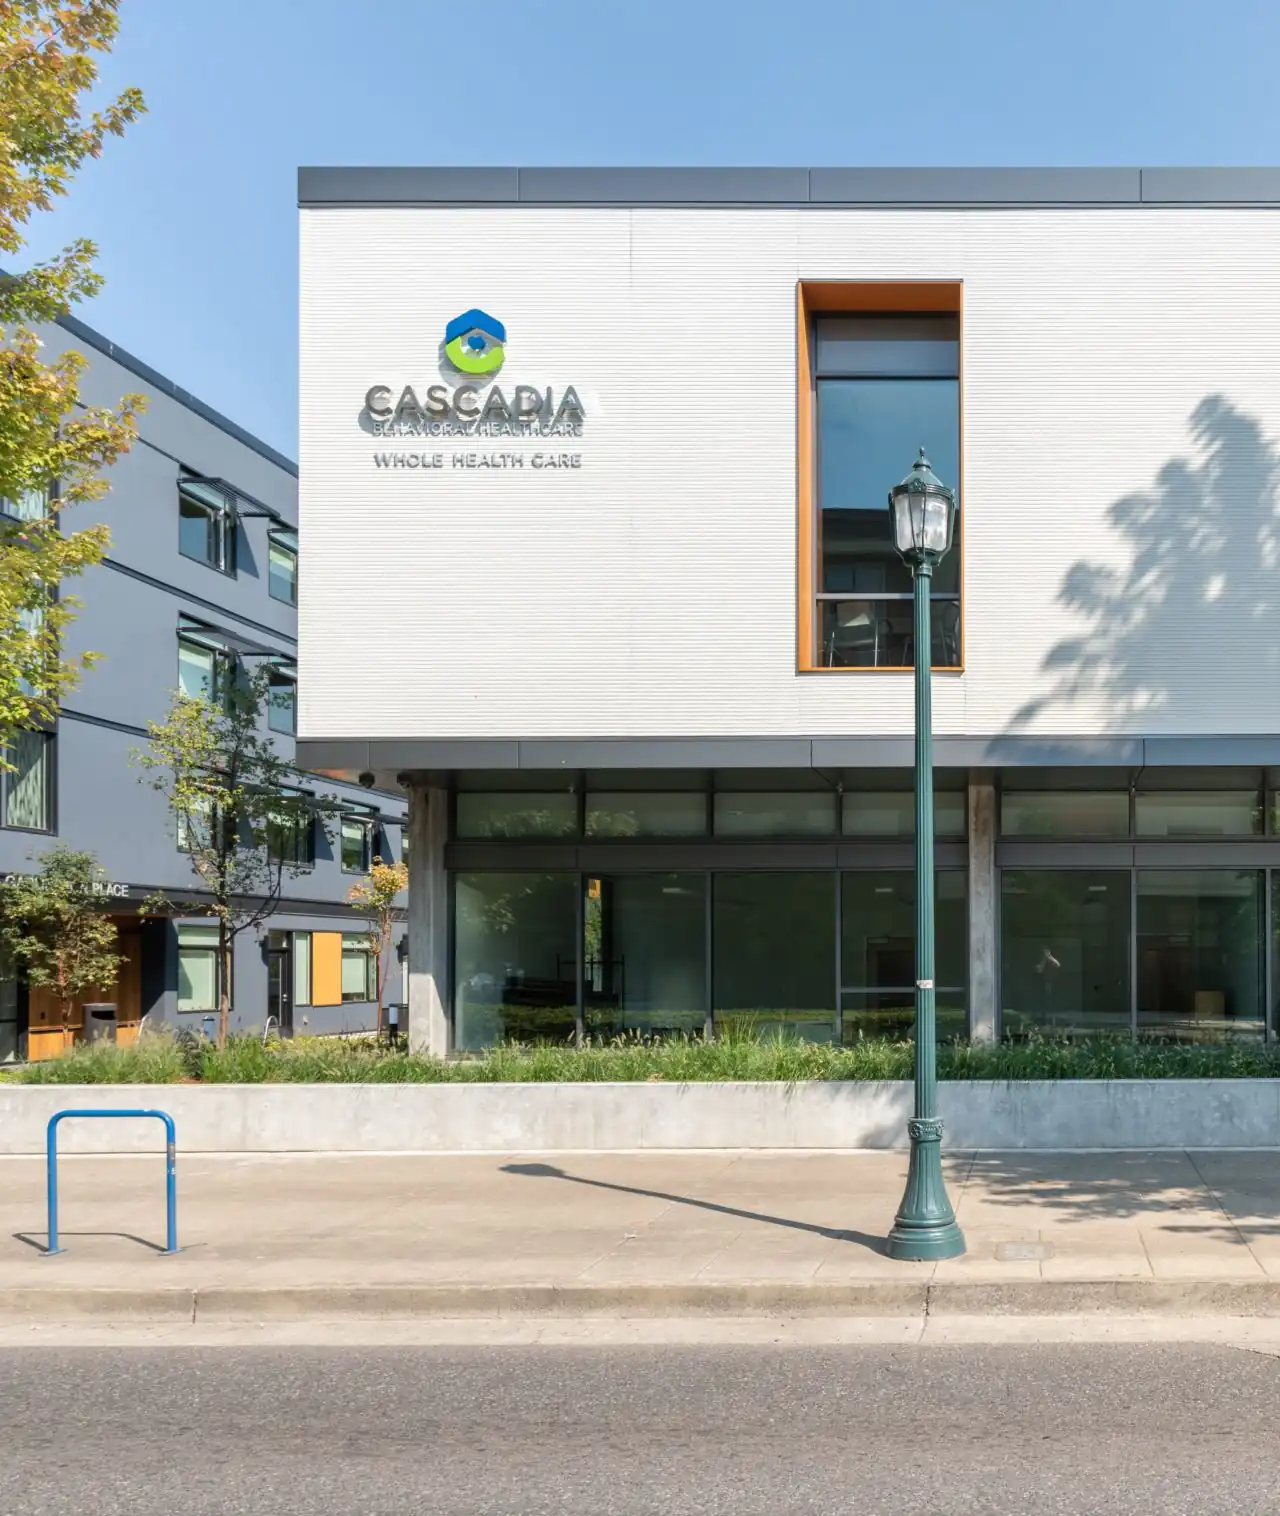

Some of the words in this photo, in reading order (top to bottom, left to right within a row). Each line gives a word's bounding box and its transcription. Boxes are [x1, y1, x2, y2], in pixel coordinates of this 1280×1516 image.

[364, 384, 586, 417] CASCADIA
[373, 422, 476, 437] BEHAVIORAL
[479, 422, 584, 437] HEALTHCARE
[373, 452, 443, 468] WHOLE
[452, 452, 523, 468] HEALTH
[530, 452, 582, 468] CARE
[91, 882, 129, 897] PLACE
